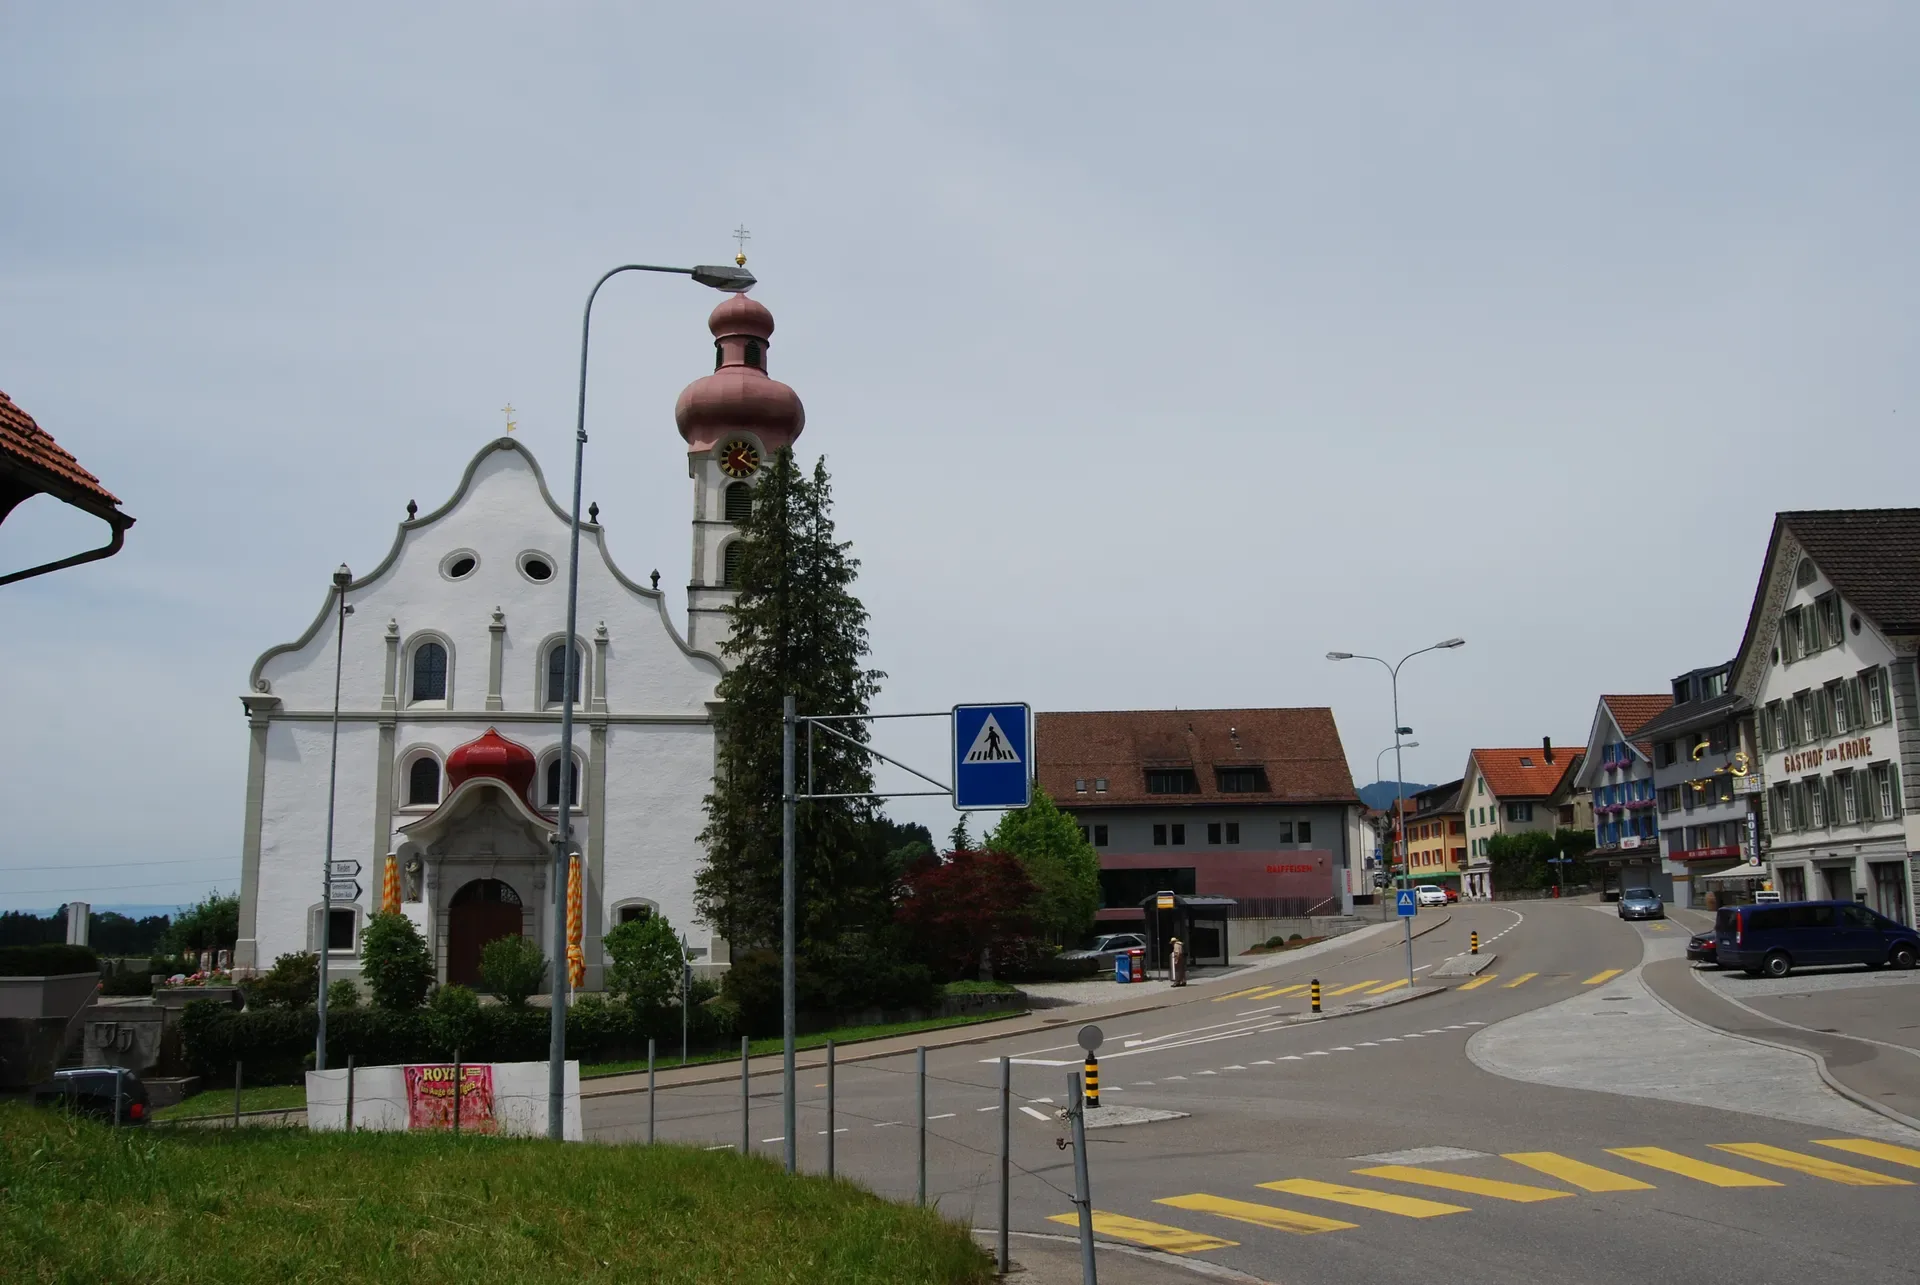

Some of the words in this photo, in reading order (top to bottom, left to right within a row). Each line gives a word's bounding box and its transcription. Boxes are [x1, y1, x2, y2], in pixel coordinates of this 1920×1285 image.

[1784, 748, 1823, 773] GASTHOF
[1839, 737, 1872, 762] KRONE
[1747, 813, 1755, 855] HOTEL
[1266, 864, 1313, 873] RAIFFEISEN
